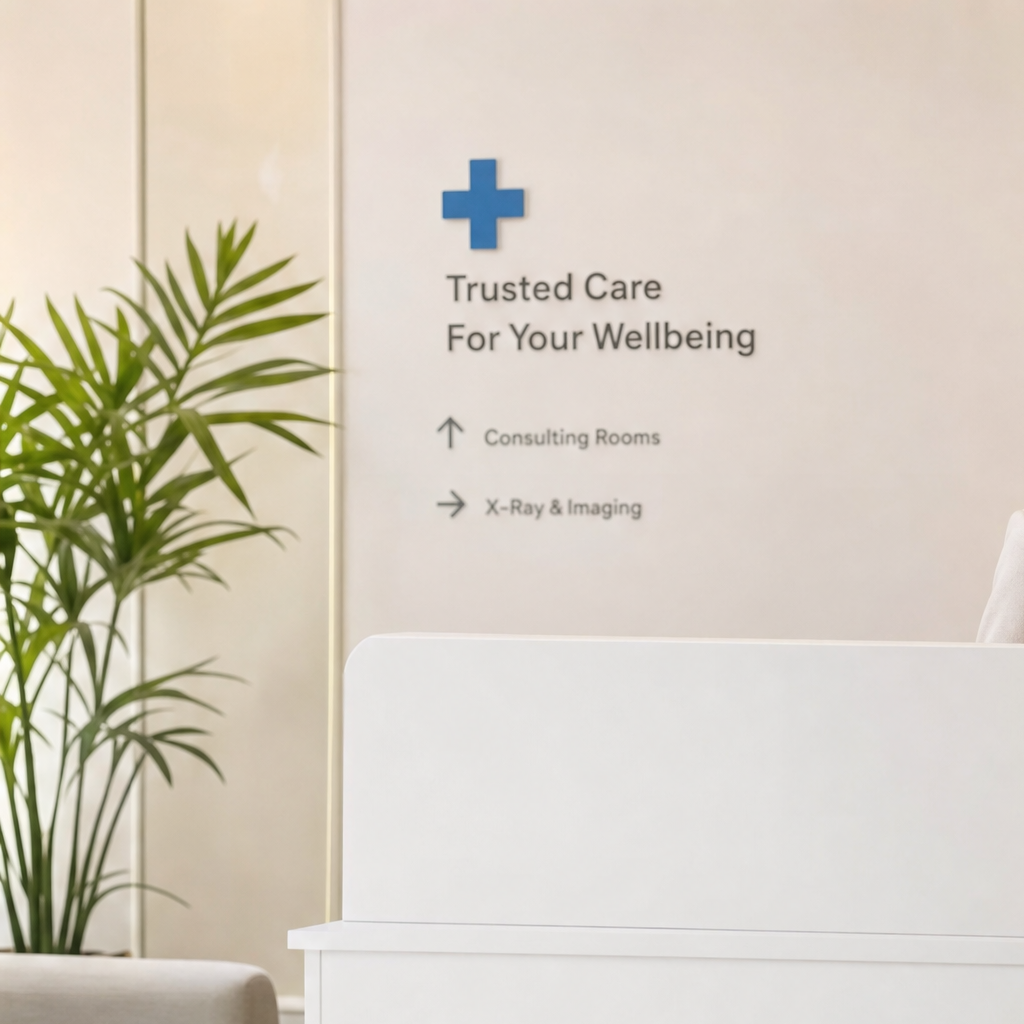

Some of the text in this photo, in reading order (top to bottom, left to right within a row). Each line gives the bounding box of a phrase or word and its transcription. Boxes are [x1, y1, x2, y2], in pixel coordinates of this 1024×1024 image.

[446, 272, 662, 303] Trusted Care
[447, 321, 756, 358] For Your Wellbeing
[484, 428, 661, 451] Consulting Rooms
[486, 498, 643, 521] X-Ray & Imaging
